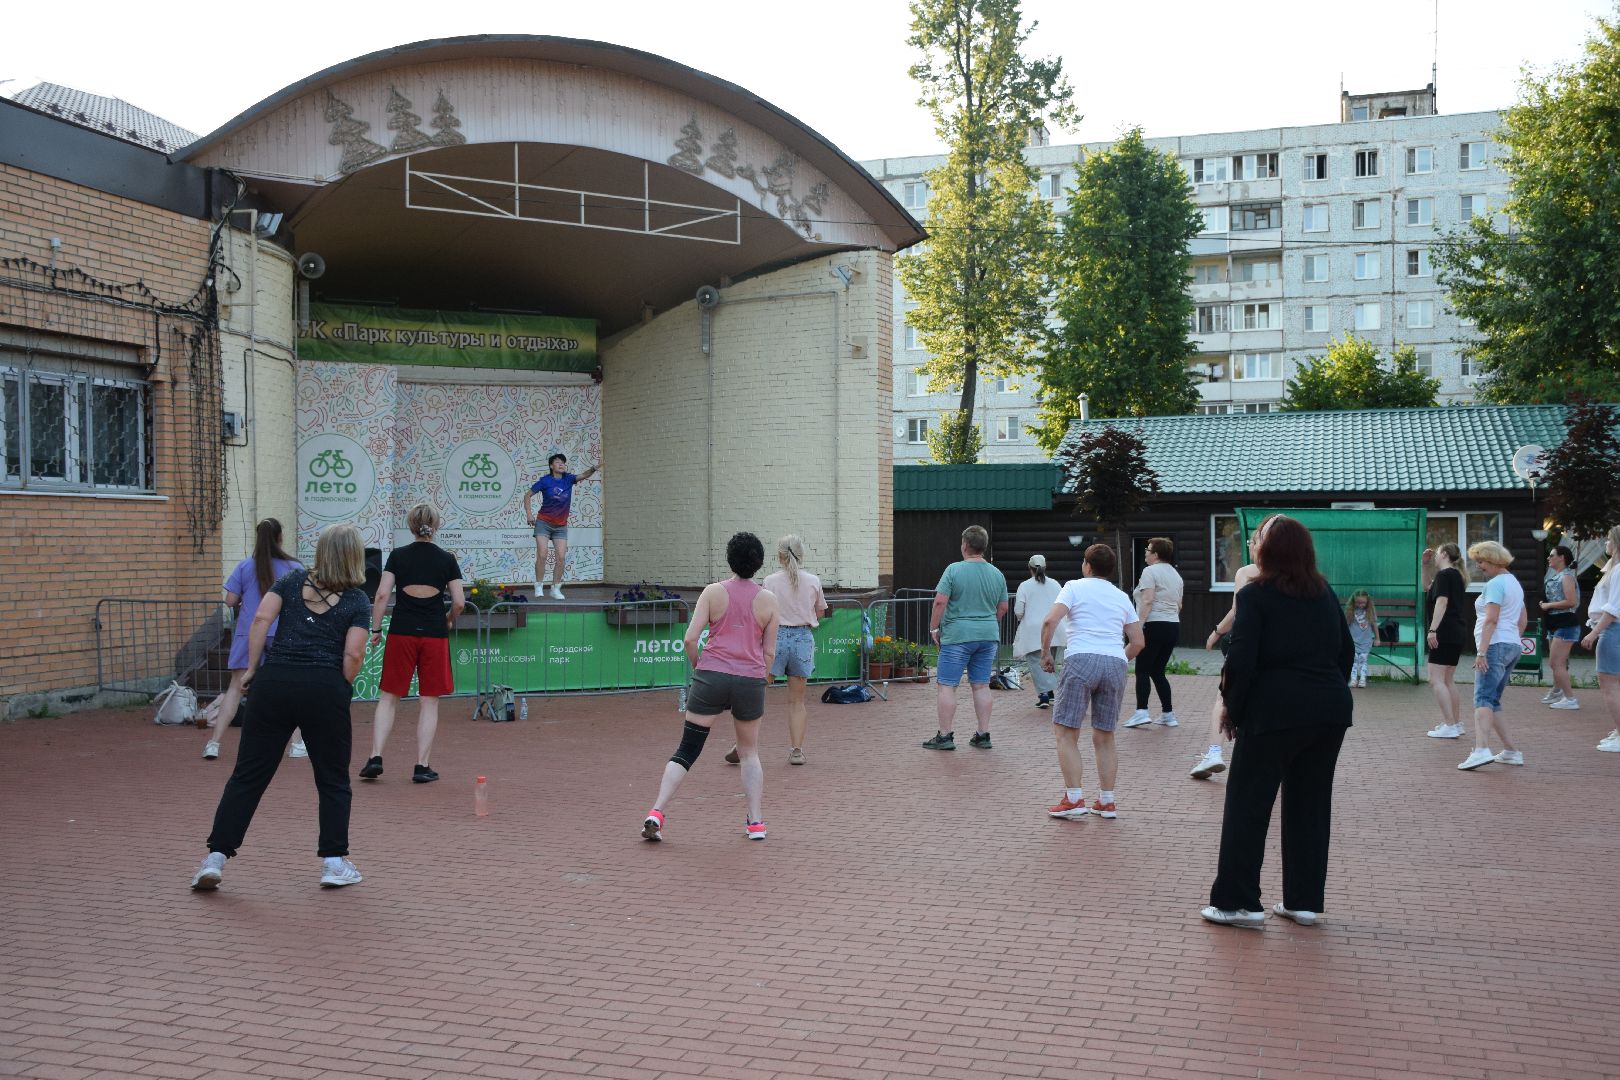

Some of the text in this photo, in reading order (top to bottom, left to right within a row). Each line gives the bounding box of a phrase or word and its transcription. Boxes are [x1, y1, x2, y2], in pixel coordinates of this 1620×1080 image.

[332, 322, 391, 344] «Парк
[396, 330, 485, 349] культуры
[491, 334, 501, 347] и
[506, 335, 578, 351] отдыха»
[549, 644, 593, 654] Городской
[549, 656, 570, 664] парк
